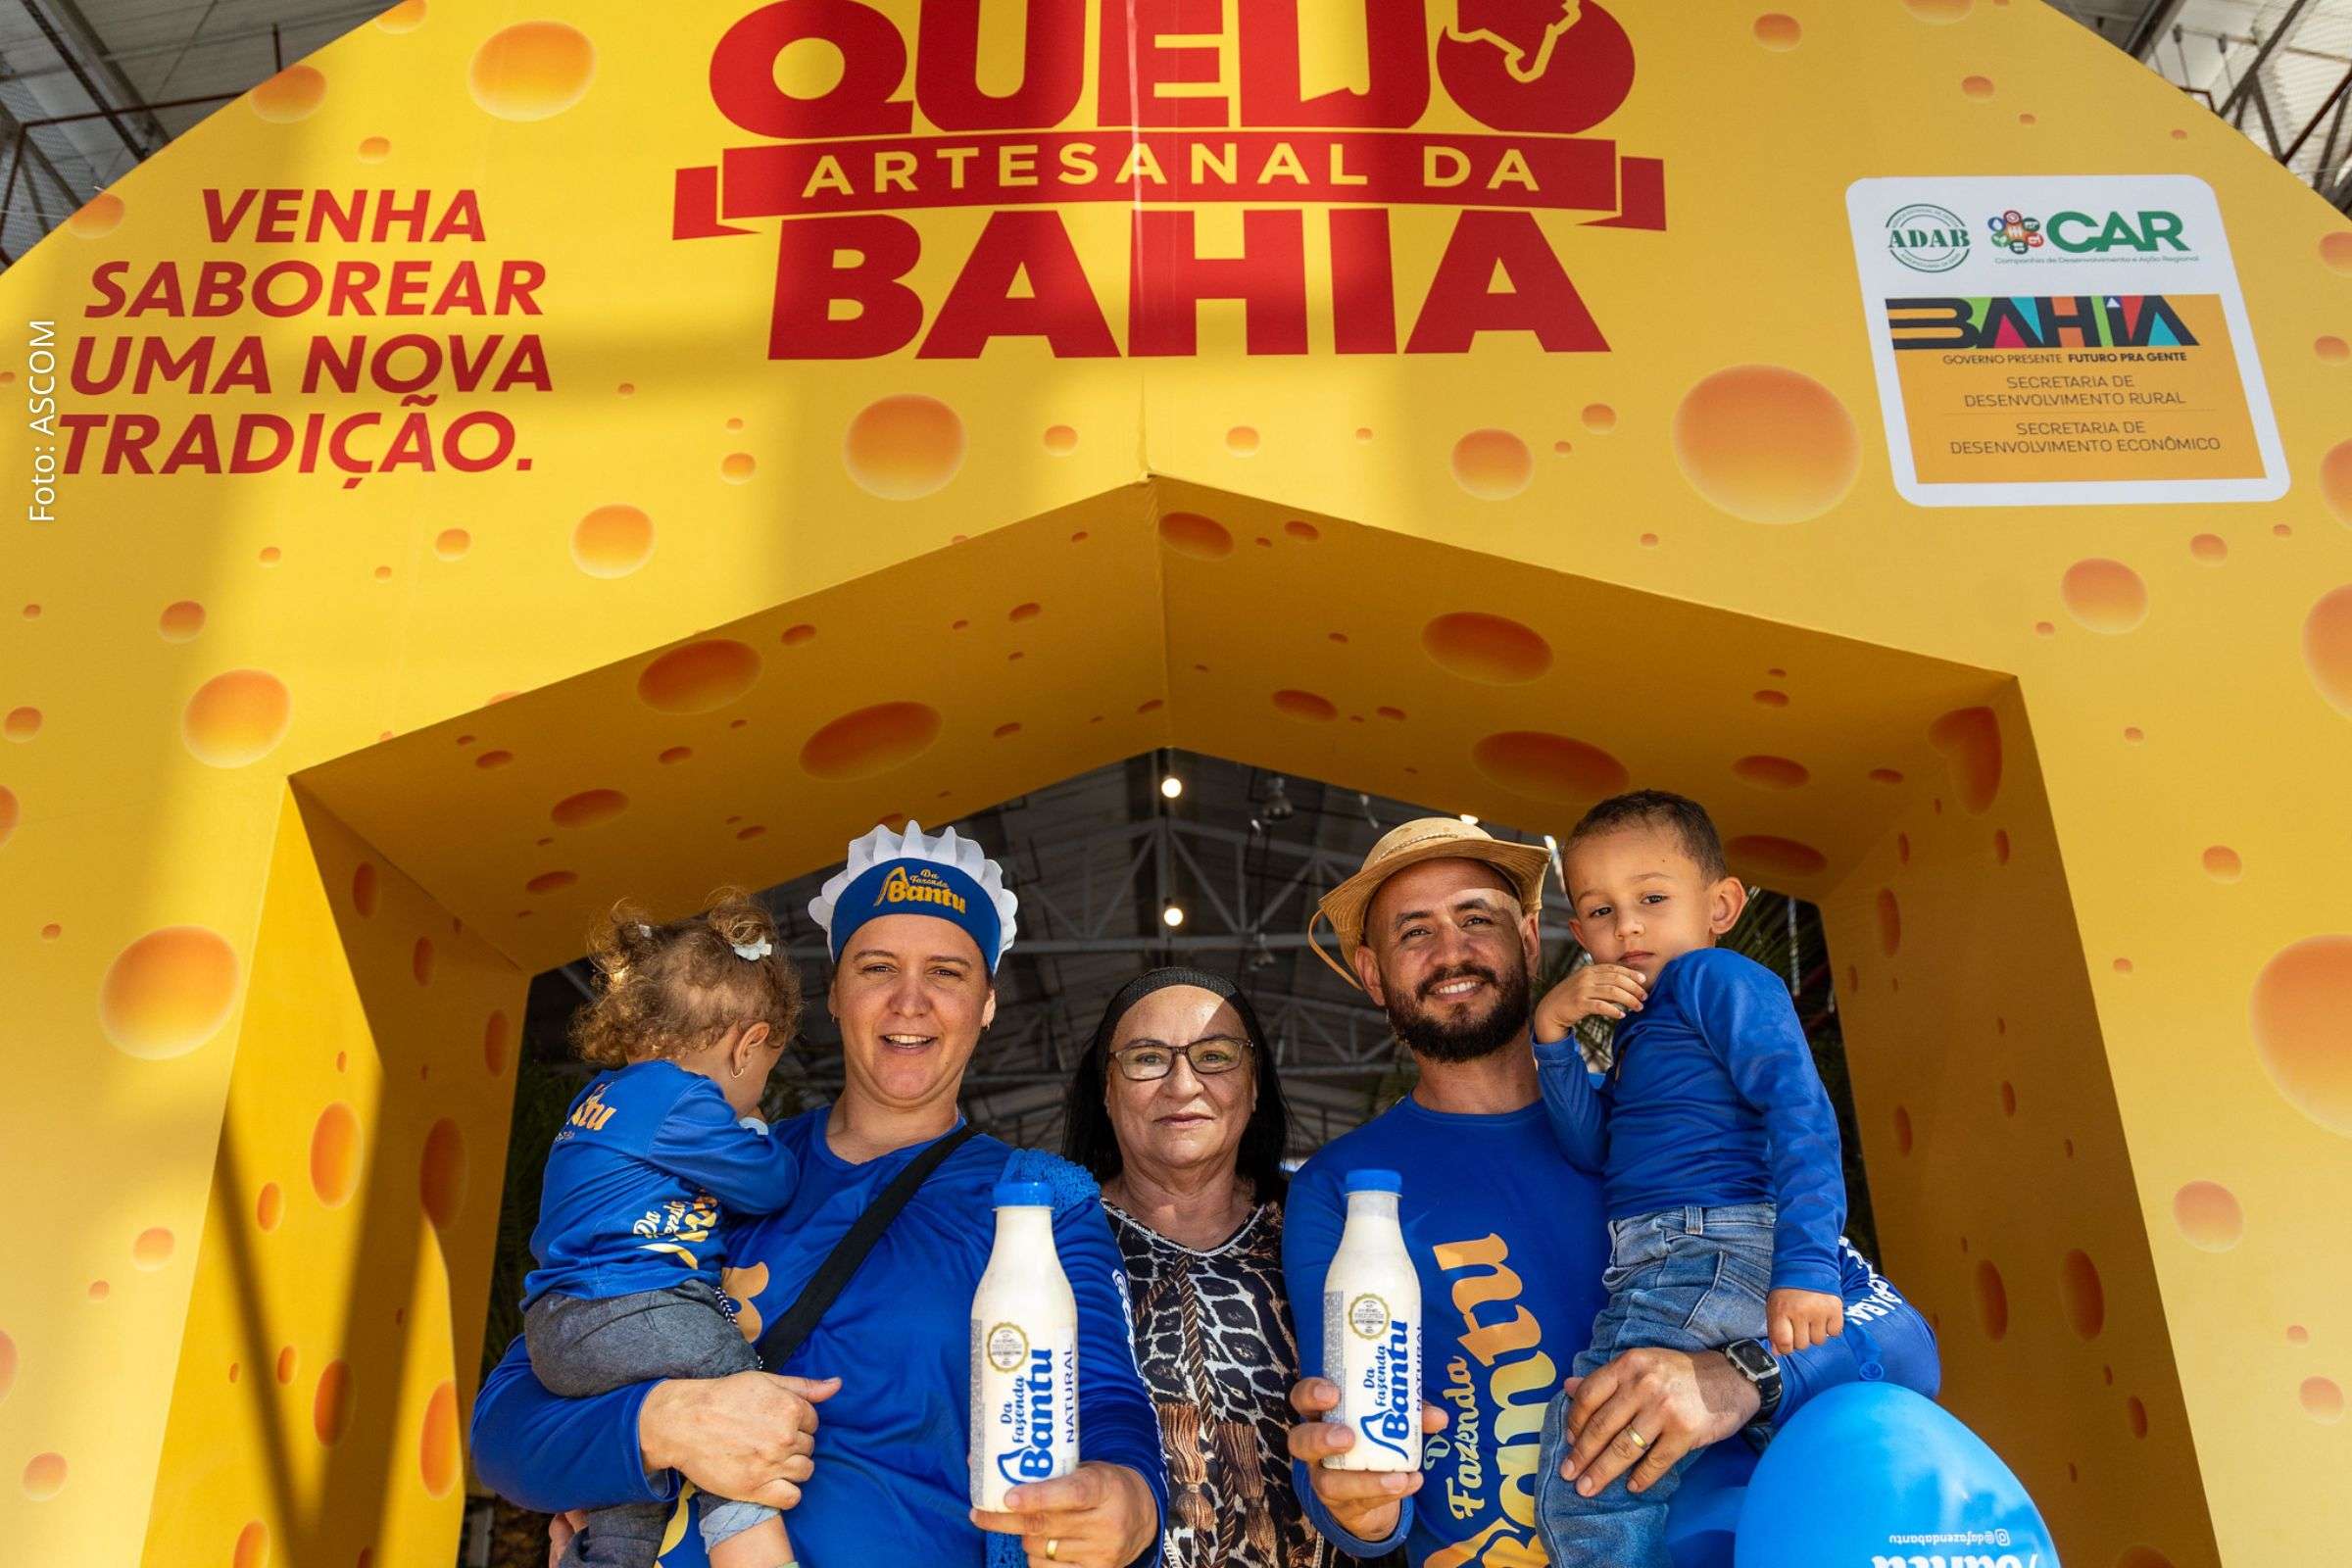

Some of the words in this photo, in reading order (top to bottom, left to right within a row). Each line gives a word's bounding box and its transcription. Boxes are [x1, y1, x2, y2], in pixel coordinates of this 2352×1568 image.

[801, 141, 1369, 198] ARTESANAL
[1423, 146, 1541, 191] DA
[203, 188, 487, 243] VENHA
[1887, 228, 1971, 248] ADAB
[2045, 210, 2191, 254] CAR
[84, 260, 546, 318] SABOREAR
[767, 208, 1612, 360] BAHIA
[1885, 295, 2201, 350] BAHIA
[70, 336, 272, 395] UMA
[301, 333, 554, 393] NOVA
[1942, 354, 2005, 365] GOVERNO
[2007, 353, 2063, 364] PRESENTE
[2069, 353, 2117, 363] FUTURO
[2120, 353, 2144, 362] PRA
[2147, 352, 2187, 362] GENTE
[2006, 376, 2108, 389] SECRETARIA
[2112, 375, 2134, 387] DE
[1964, 392, 2125, 408] DESENVOLVIMENTO
[2130, 392, 2186, 405] RURAL
[58, 394, 533, 488] TRADIÇÃO.
[1950, 440, 2112, 455] DESENVOLVIMENTO
[2118, 436, 2221, 452] ECONÔMICO
[2016, 422, 2120, 435] SECRETARIA
[2124, 421, 2146, 433] DE
[887, 881, 966, 914] Bantu
[920, 868, 940, 879] Da
[1064, 1344, 1074, 1444] NATURAL
[1363, 1366, 1376, 1389] Da
[1375, 1344, 1388, 1407] Fazenda
[1382, 1320, 1409, 1440] Bantu
[1000, 1401, 1013, 1424] Da
[1011, 1375, 1026, 1444] Fazenda
[1020, 1348, 1054, 1478] Bantu
[1443, 1355, 1487, 1520] Fazenda
